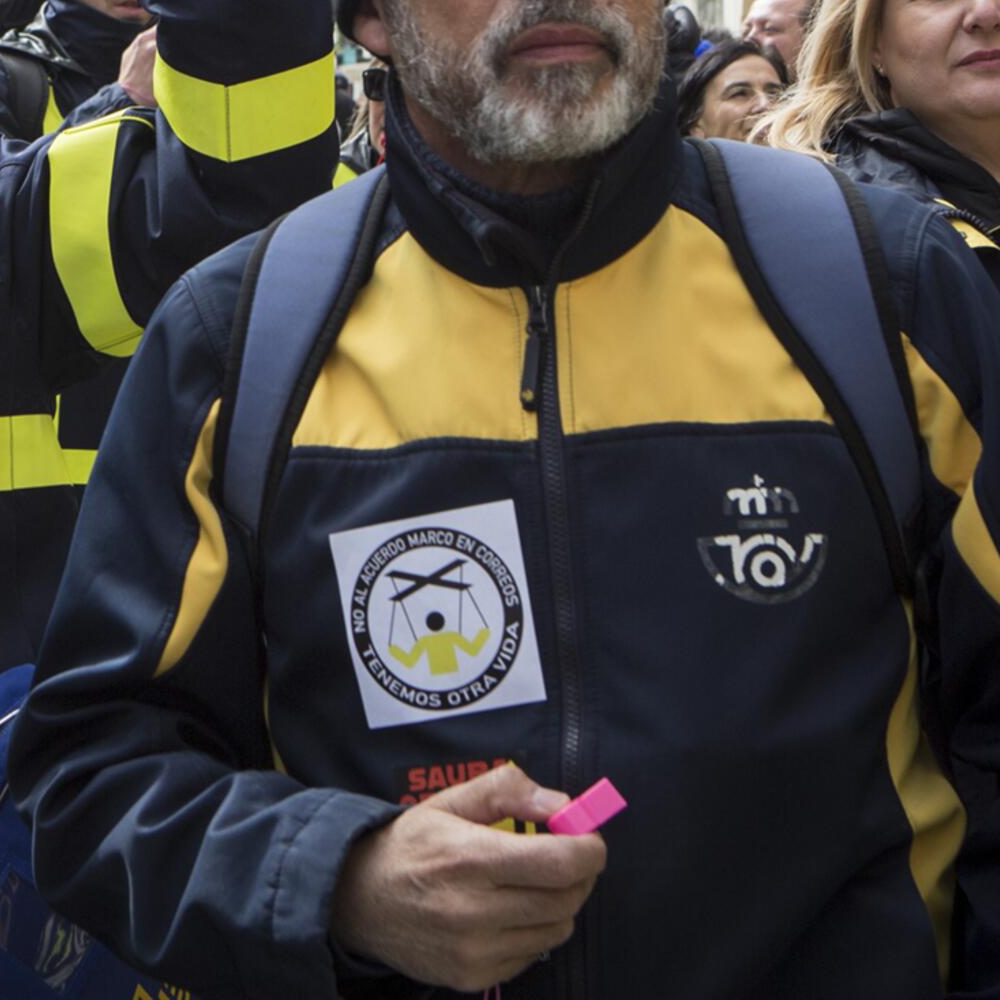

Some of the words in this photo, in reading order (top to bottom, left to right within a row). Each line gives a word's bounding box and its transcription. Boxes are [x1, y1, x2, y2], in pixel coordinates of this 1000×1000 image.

[407, 530, 454, 547] MARCO
[456, 534, 474, 553] EN
[363, 538, 407, 591] ACUERDO
[475, 546, 520, 607] CORREOS
[355, 587, 369, 607] AL
[353, 609, 366, 633] NO
[362, 643, 441, 708] TENEMOS
[447, 675, 497, 706] OTRA
[493, 620, 520, 671] VIDA
